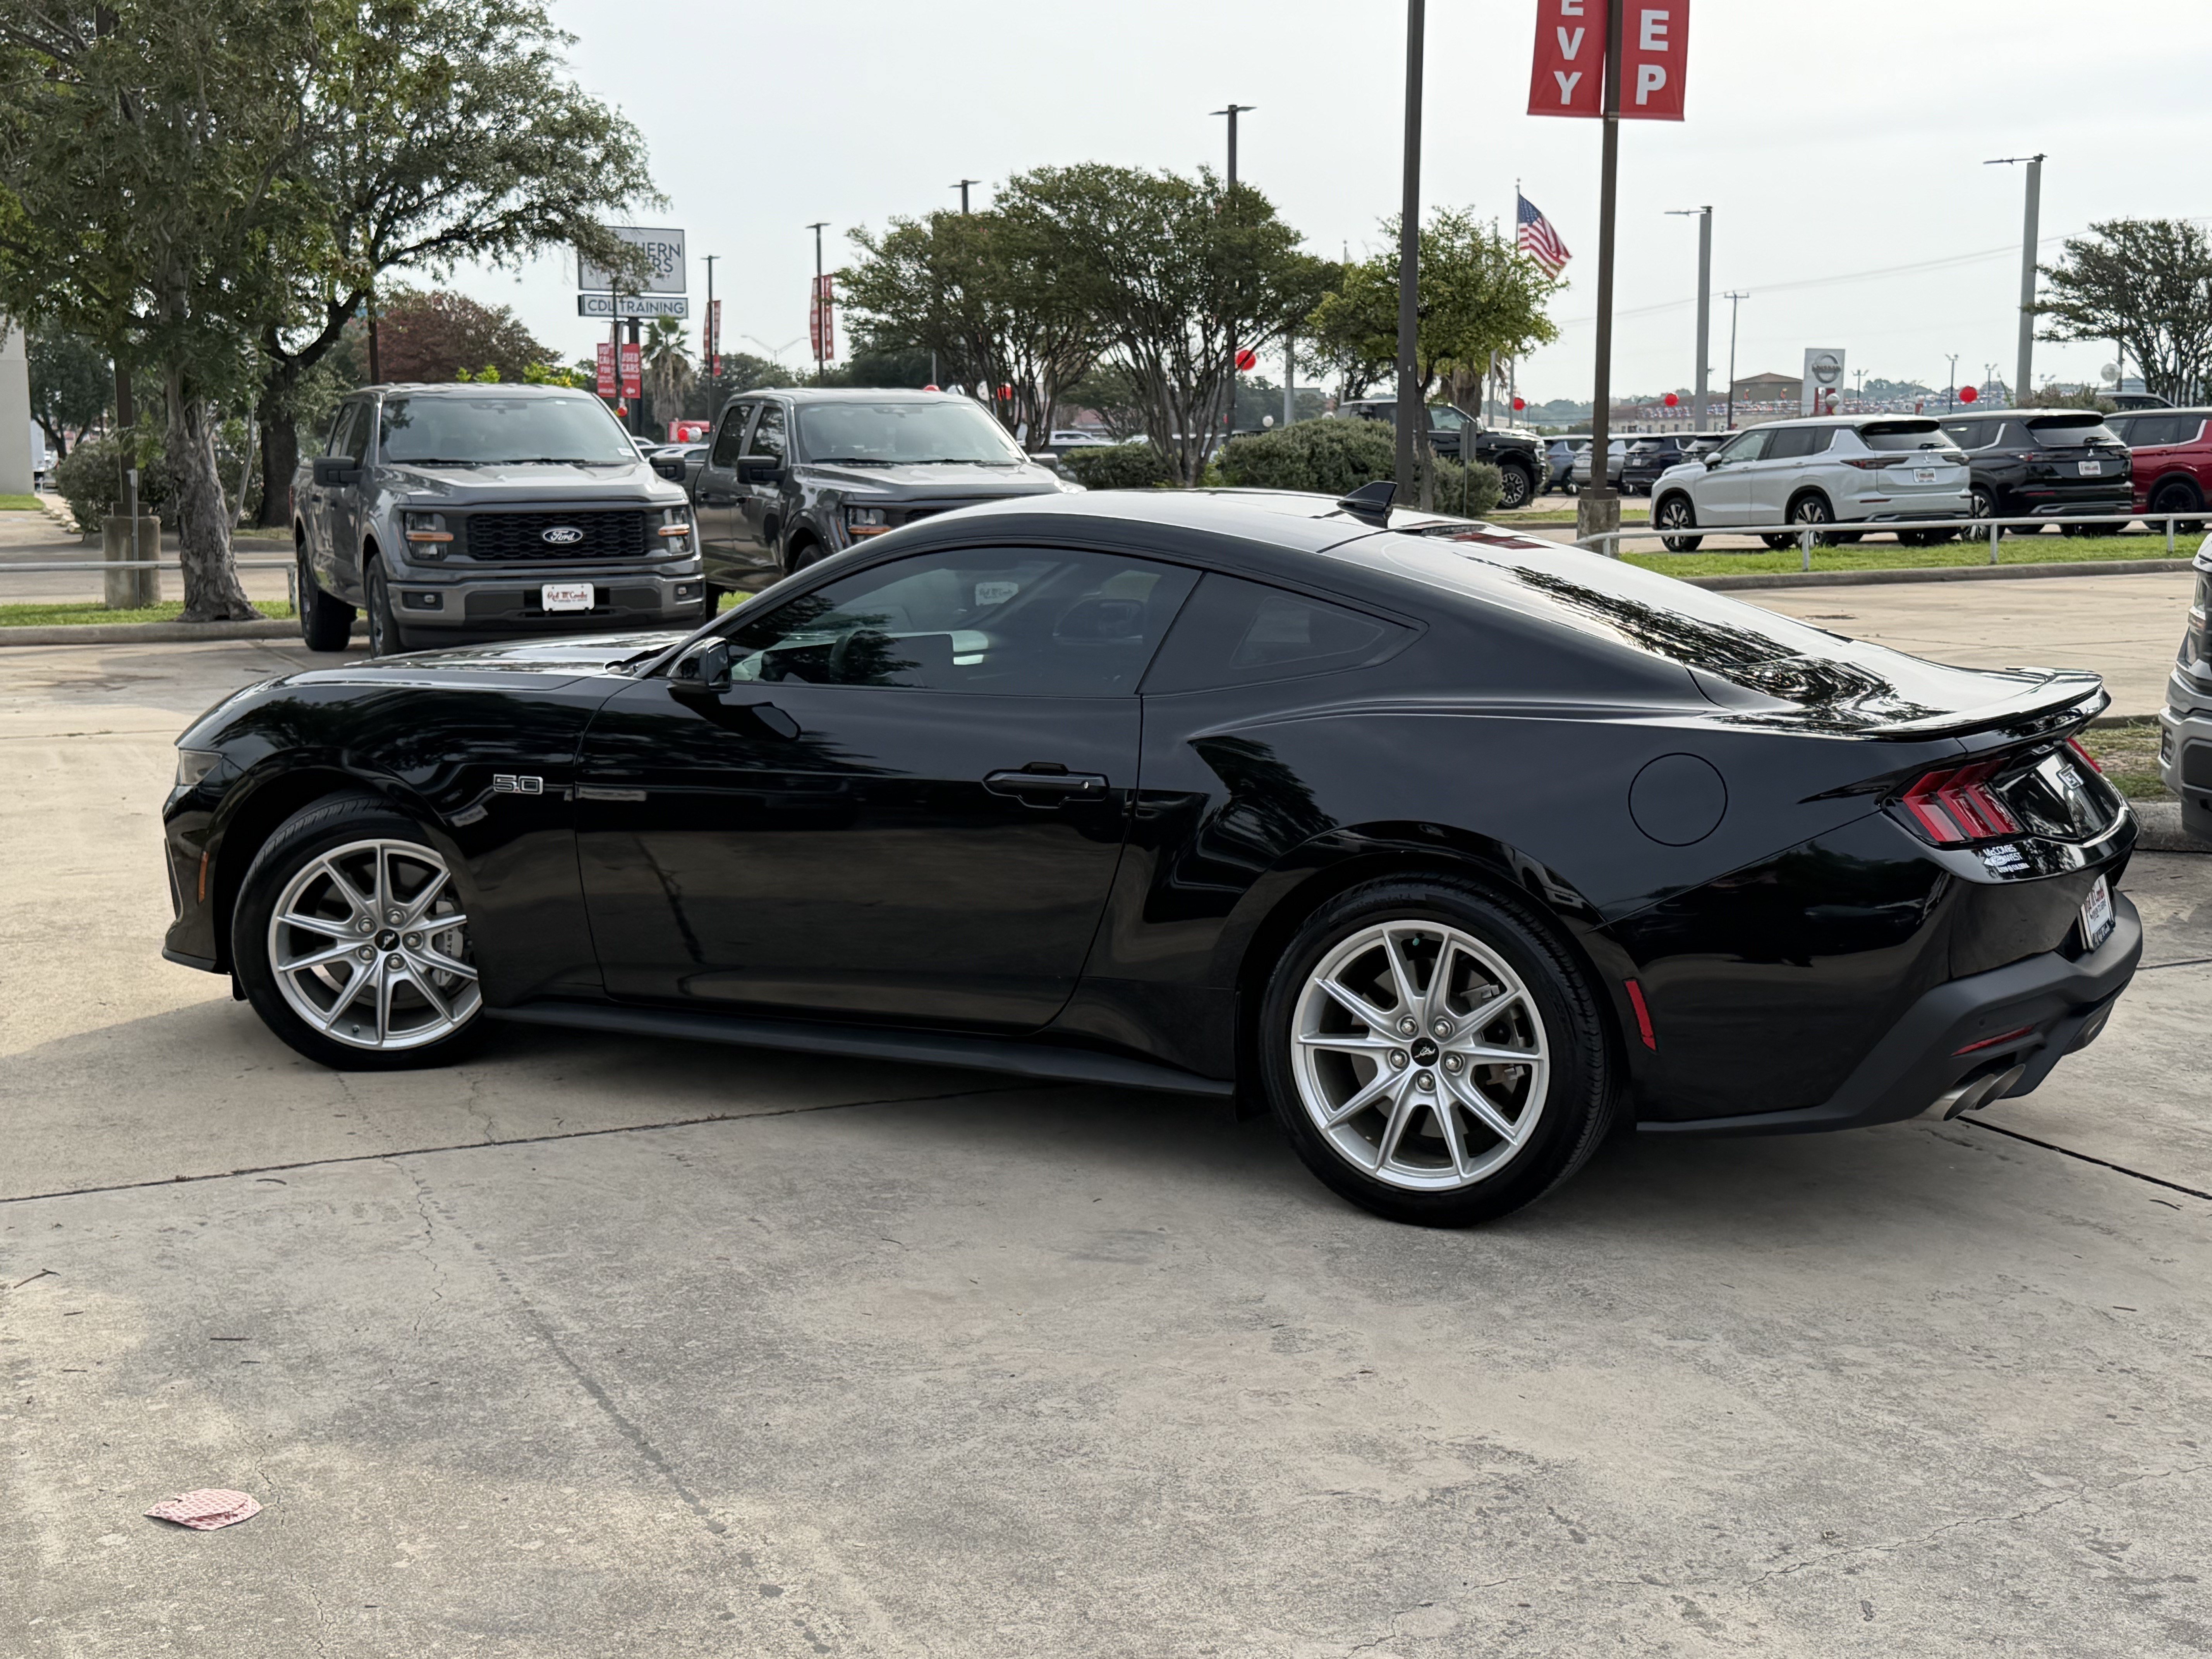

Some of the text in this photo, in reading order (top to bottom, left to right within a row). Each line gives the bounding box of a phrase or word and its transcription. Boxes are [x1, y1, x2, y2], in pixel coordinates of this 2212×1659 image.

[588, 300, 684, 314] CDL TRAINING
[550, 530, 576, 541] Ford
[493, 774, 543, 795] 5.0
